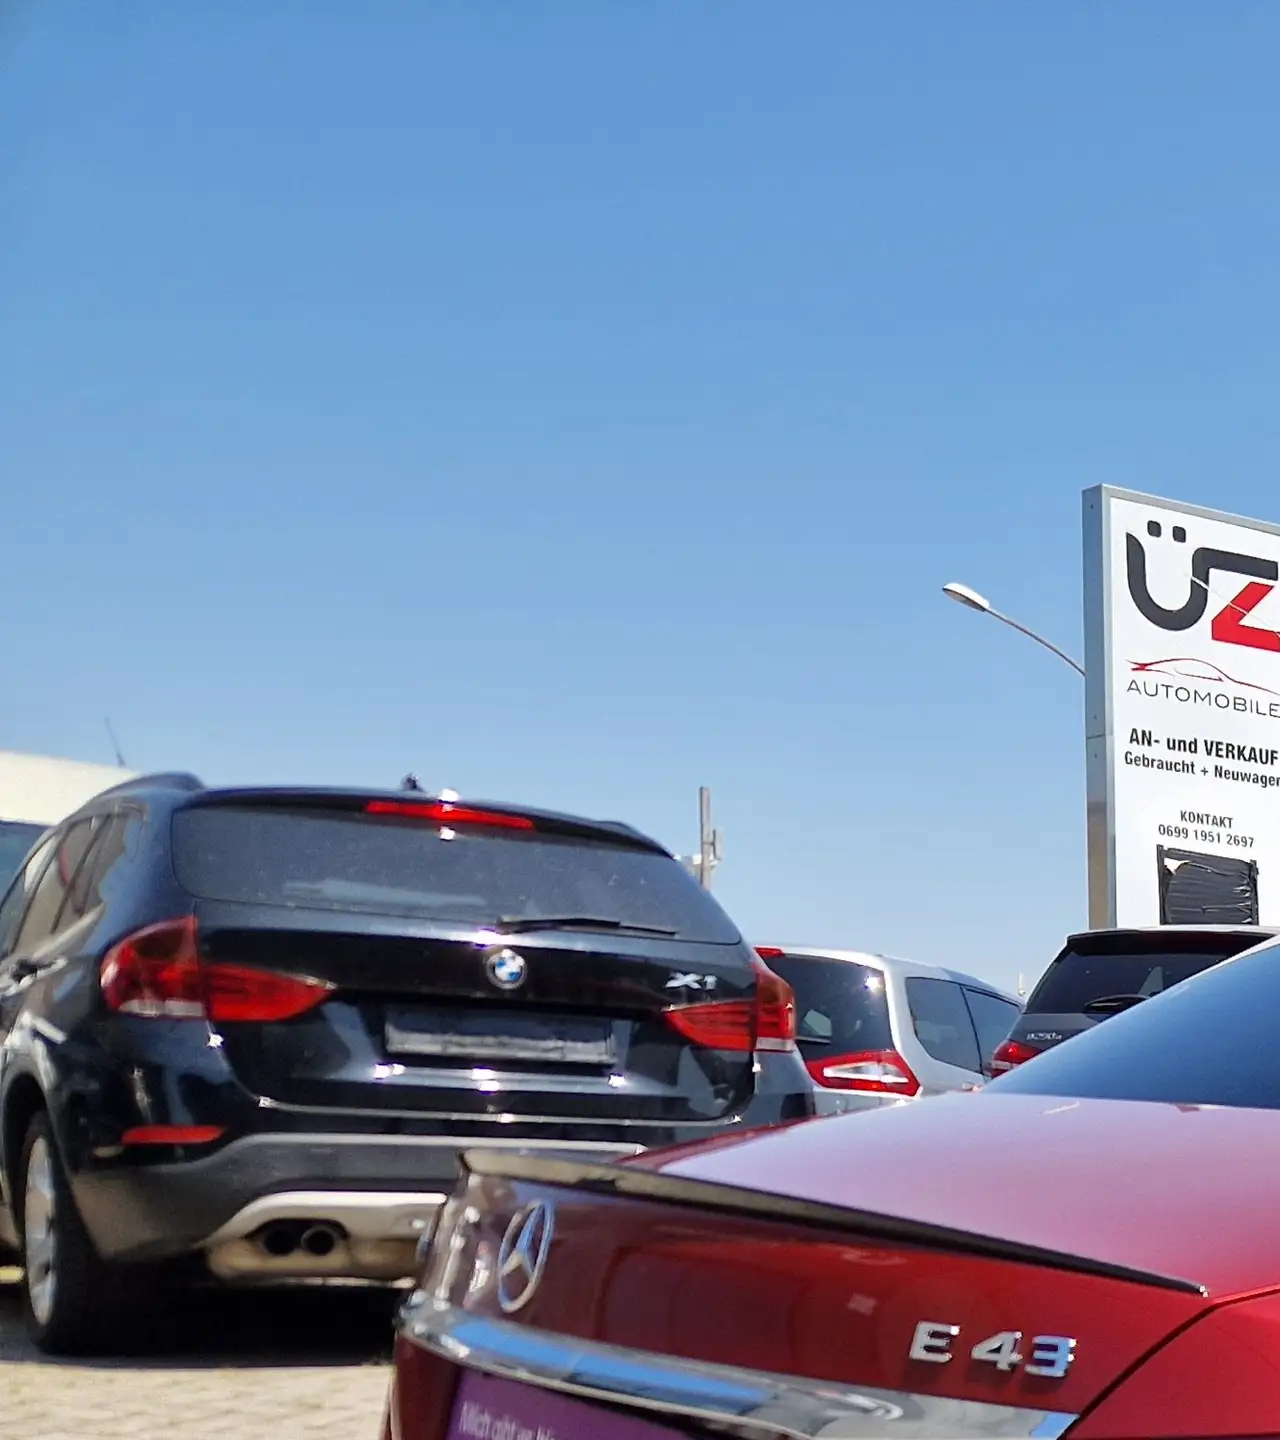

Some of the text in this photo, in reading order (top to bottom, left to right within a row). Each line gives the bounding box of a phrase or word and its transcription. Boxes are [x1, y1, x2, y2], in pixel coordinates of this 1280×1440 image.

[1126, 679, 1280, 718] AUTOMOBILE
[1129, 728, 1279, 766] AN- und VERKAUF
[1124, 751, 1196, 775] Gebraucht
[1180, 810, 1233, 829] KONTAKT
[1158, 824, 1255, 848] 0699 1951 2697
[909, 1321, 1078, 1378] E 43
